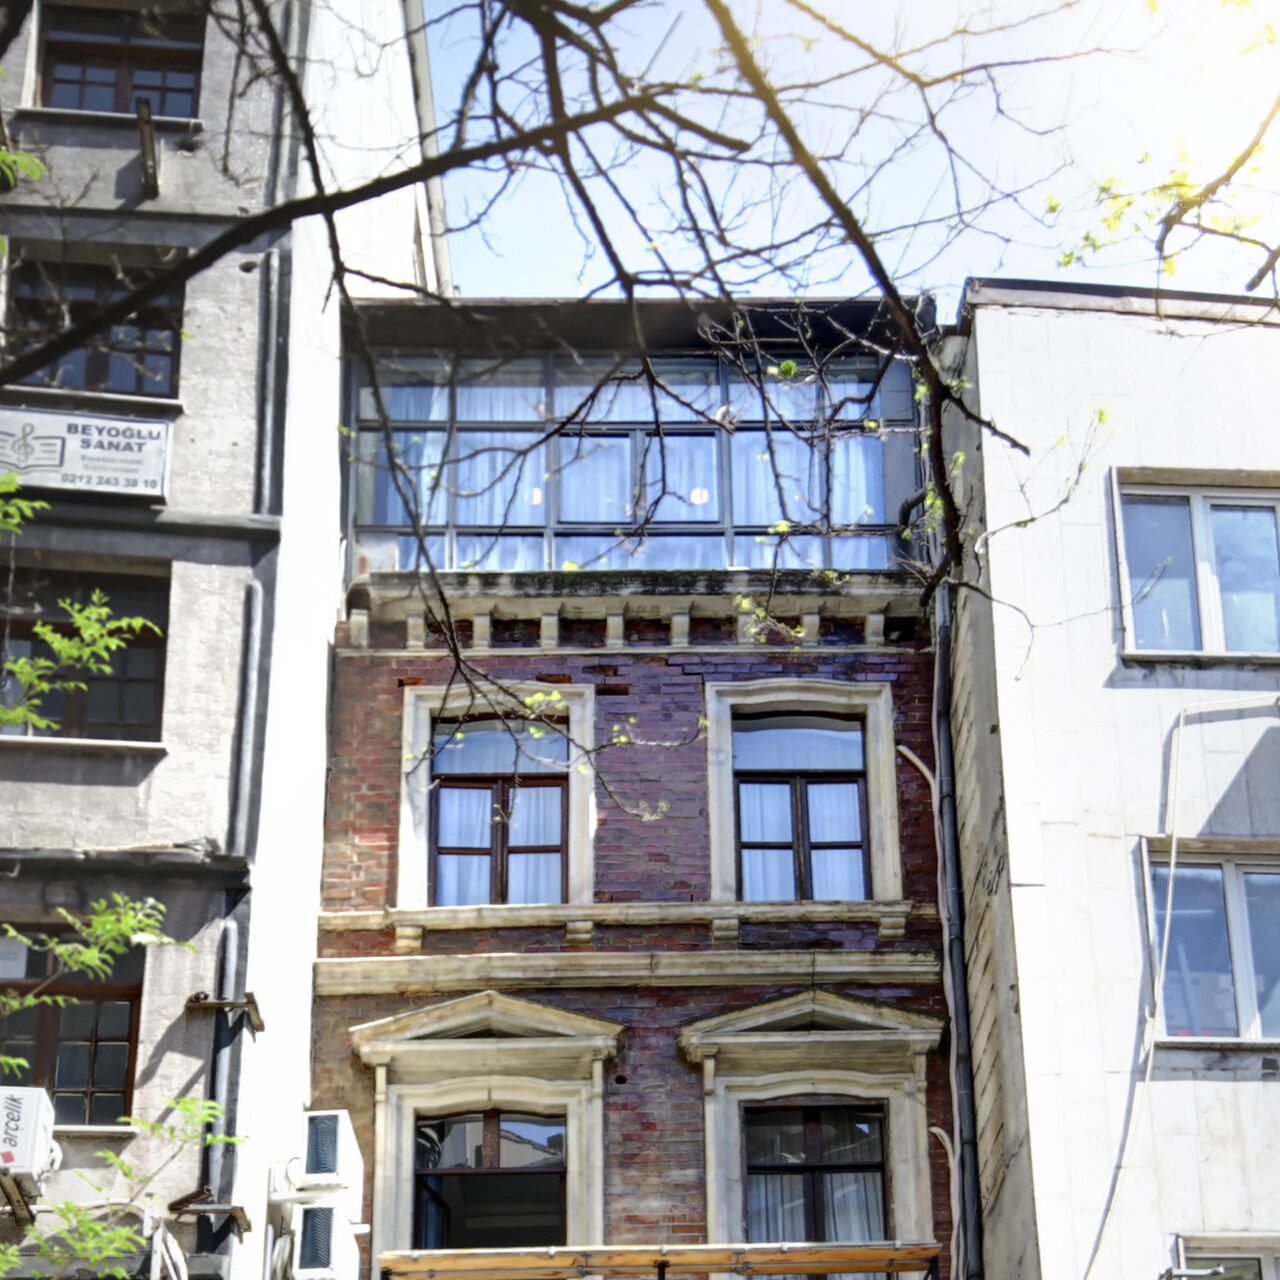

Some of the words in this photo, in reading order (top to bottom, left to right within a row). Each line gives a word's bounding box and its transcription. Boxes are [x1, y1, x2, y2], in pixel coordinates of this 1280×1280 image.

[66, 422, 161, 440] BEYOĞLU
[80, 438, 147, 453] SANAT
[61, 473, 92, 484] 0212
[96, 475, 119, 486] 243
